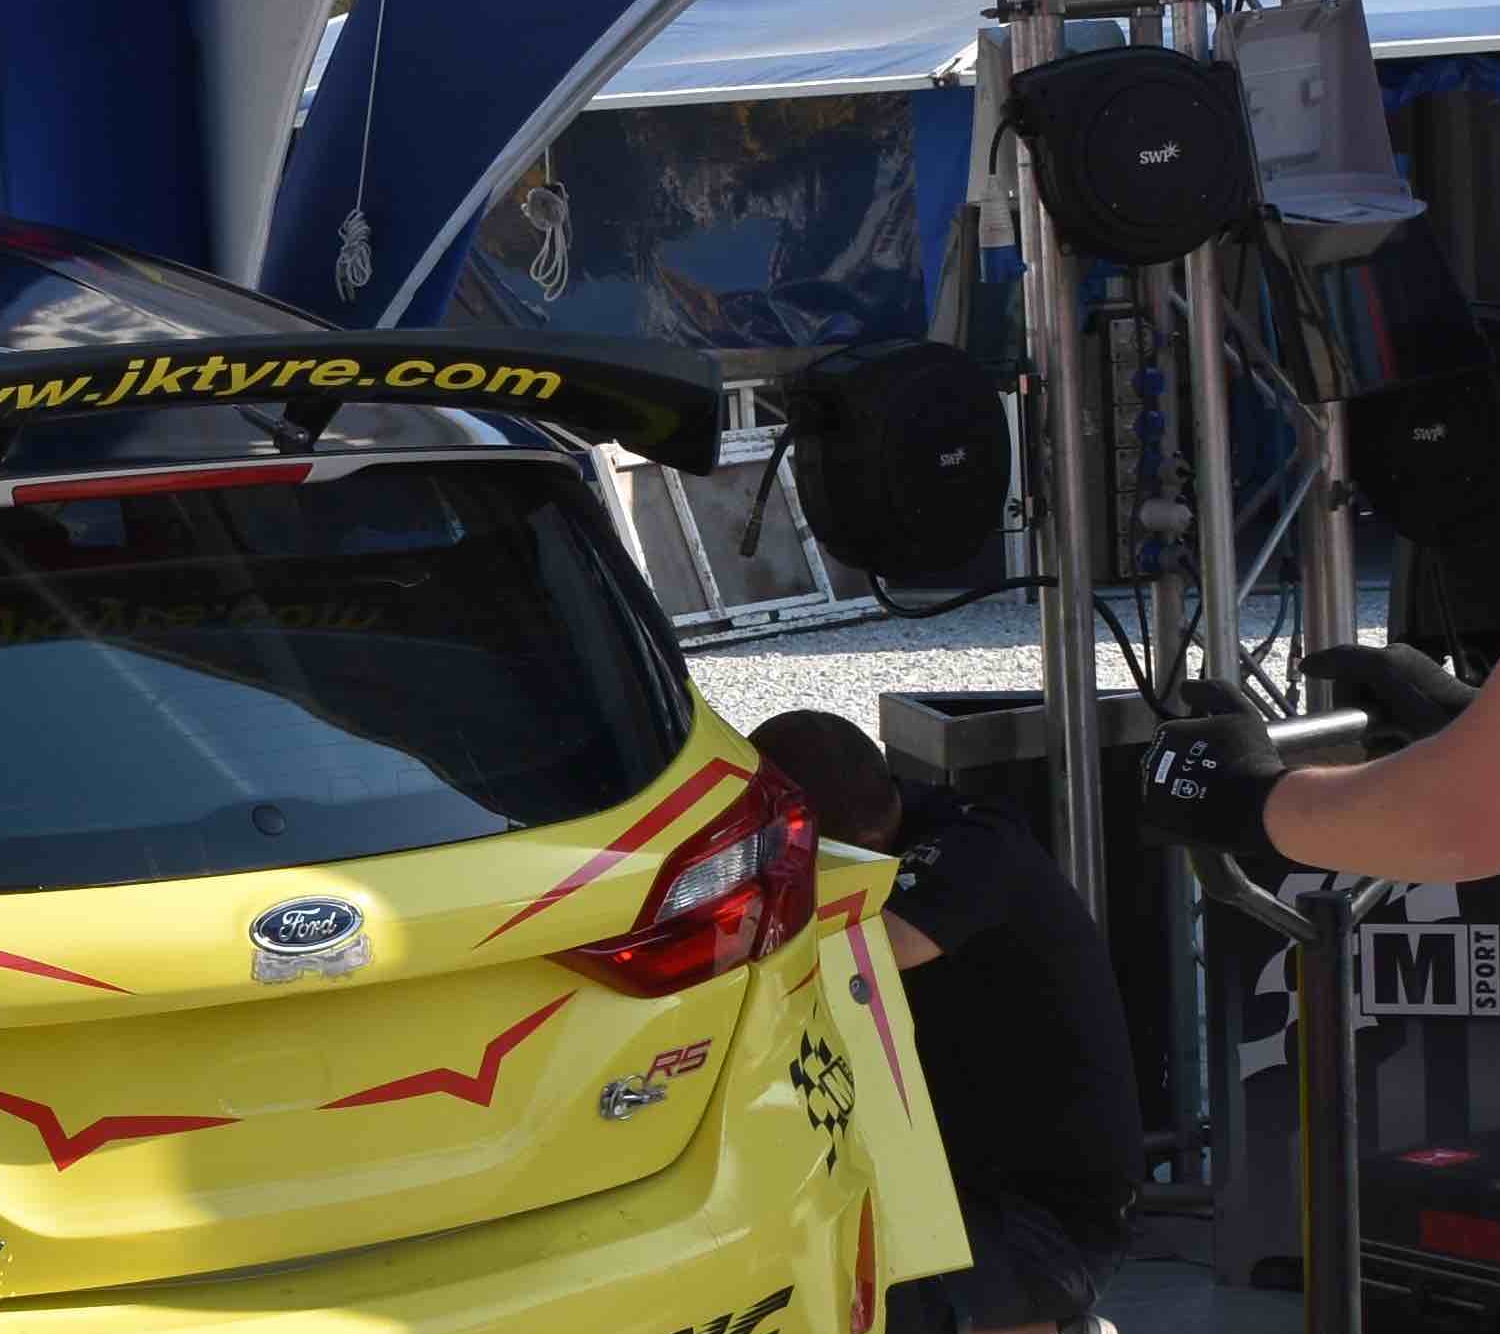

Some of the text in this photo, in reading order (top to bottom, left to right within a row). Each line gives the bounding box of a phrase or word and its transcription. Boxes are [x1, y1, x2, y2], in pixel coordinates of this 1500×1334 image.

[279, 907, 337, 942] Ford
[1372, 933, 1457, 1005] M
[1474, 930, 1498, 1009] SPORT
